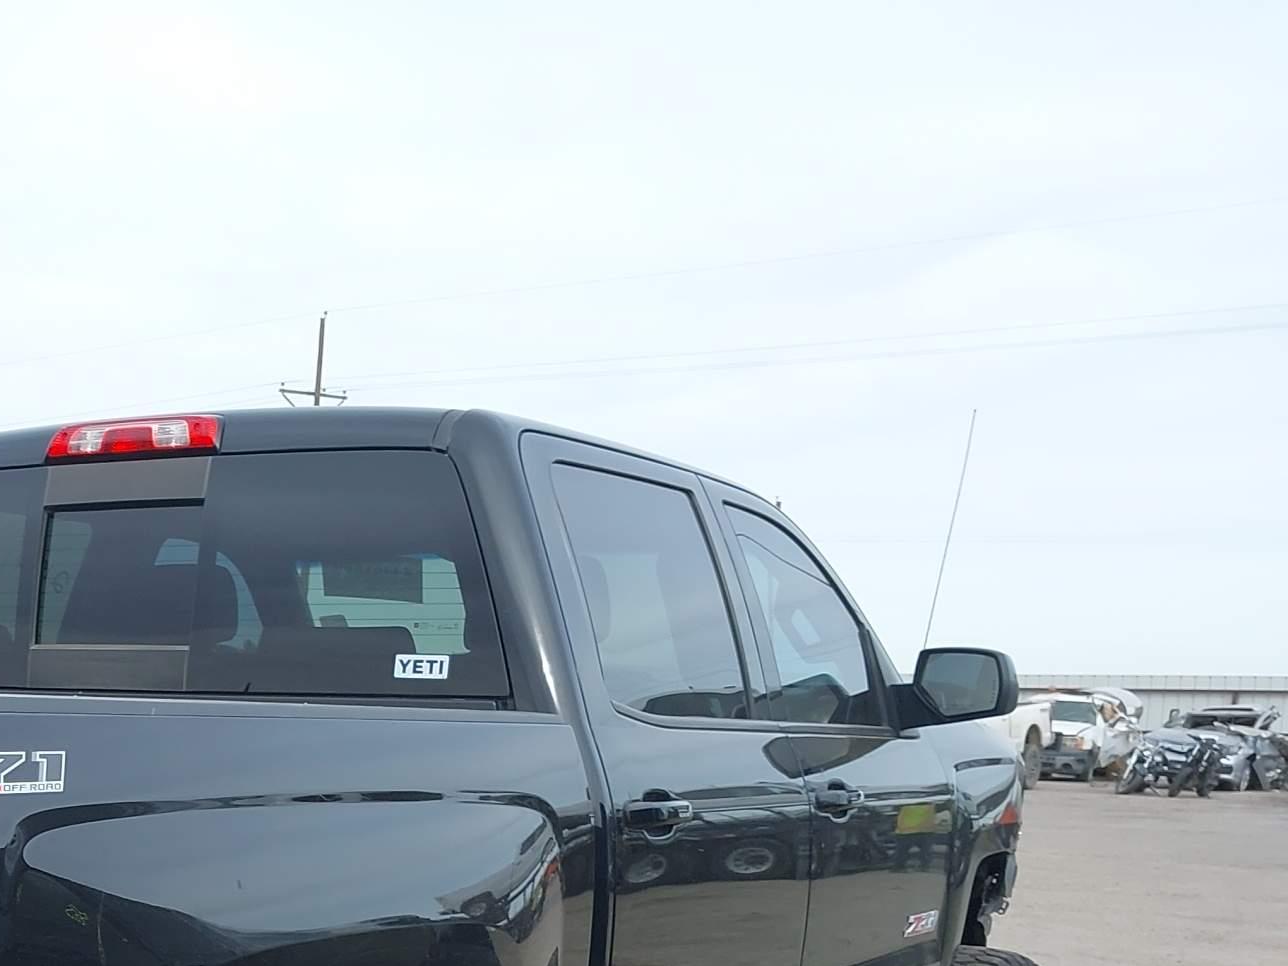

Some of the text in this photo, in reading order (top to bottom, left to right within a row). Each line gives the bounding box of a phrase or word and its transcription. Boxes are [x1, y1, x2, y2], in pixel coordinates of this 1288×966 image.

[398, 659, 445, 675] YETI
[3, 782, 62, 793] OFF ROAD
